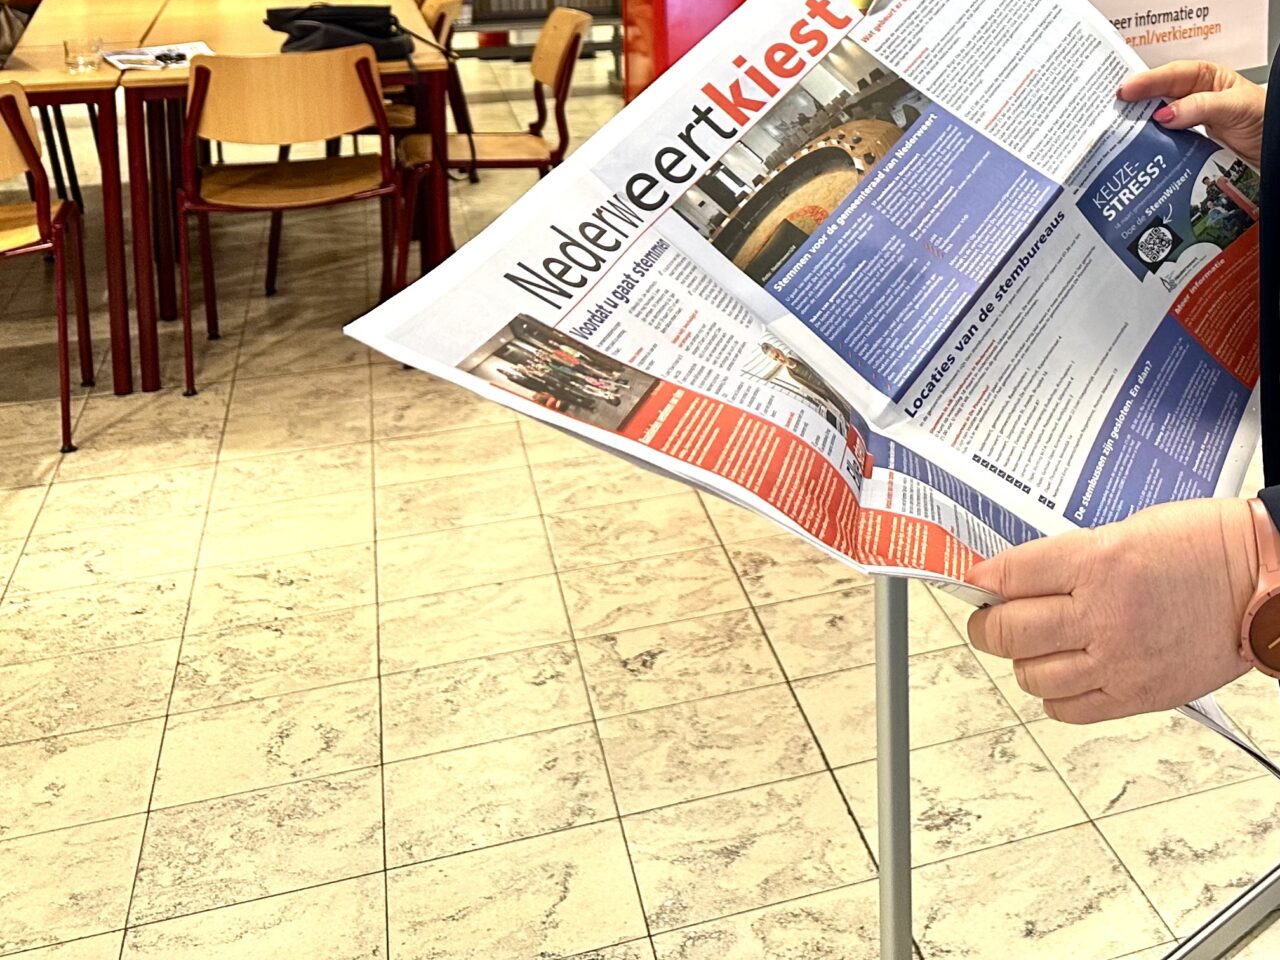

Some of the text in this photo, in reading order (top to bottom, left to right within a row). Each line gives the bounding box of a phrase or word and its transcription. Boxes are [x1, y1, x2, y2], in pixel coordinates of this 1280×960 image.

[860, 30, 876, 44] Wat
[873, 7, 897, 33] gebeurt
[1135, 5, 1194, 28] informatie
[1196, 6, 1210, 21] op
[773, 113, 938, 293] Stemmen voor de gemeenteraad van Nederweert
[1092, 161, 1140, 209] KEUZE-
[1102, 154, 1167, 222] STRESS?
[1120, 168, 1192, 240] Doe de StemWijzer!
[569, 238, 671, 347] Voordat u gaat stemmen
[1188, 258, 1226, 295] informatie
[903, 210, 1065, 419] Locaties van de stembureaus
[1081, 455, 1107, 507] stembussen
[1102, 438, 1115, 456] zijn
[1110, 399, 1134, 440] gesloten.
[1129, 384, 1141, 398] En
[1137, 360, 1153, 385] dan?
